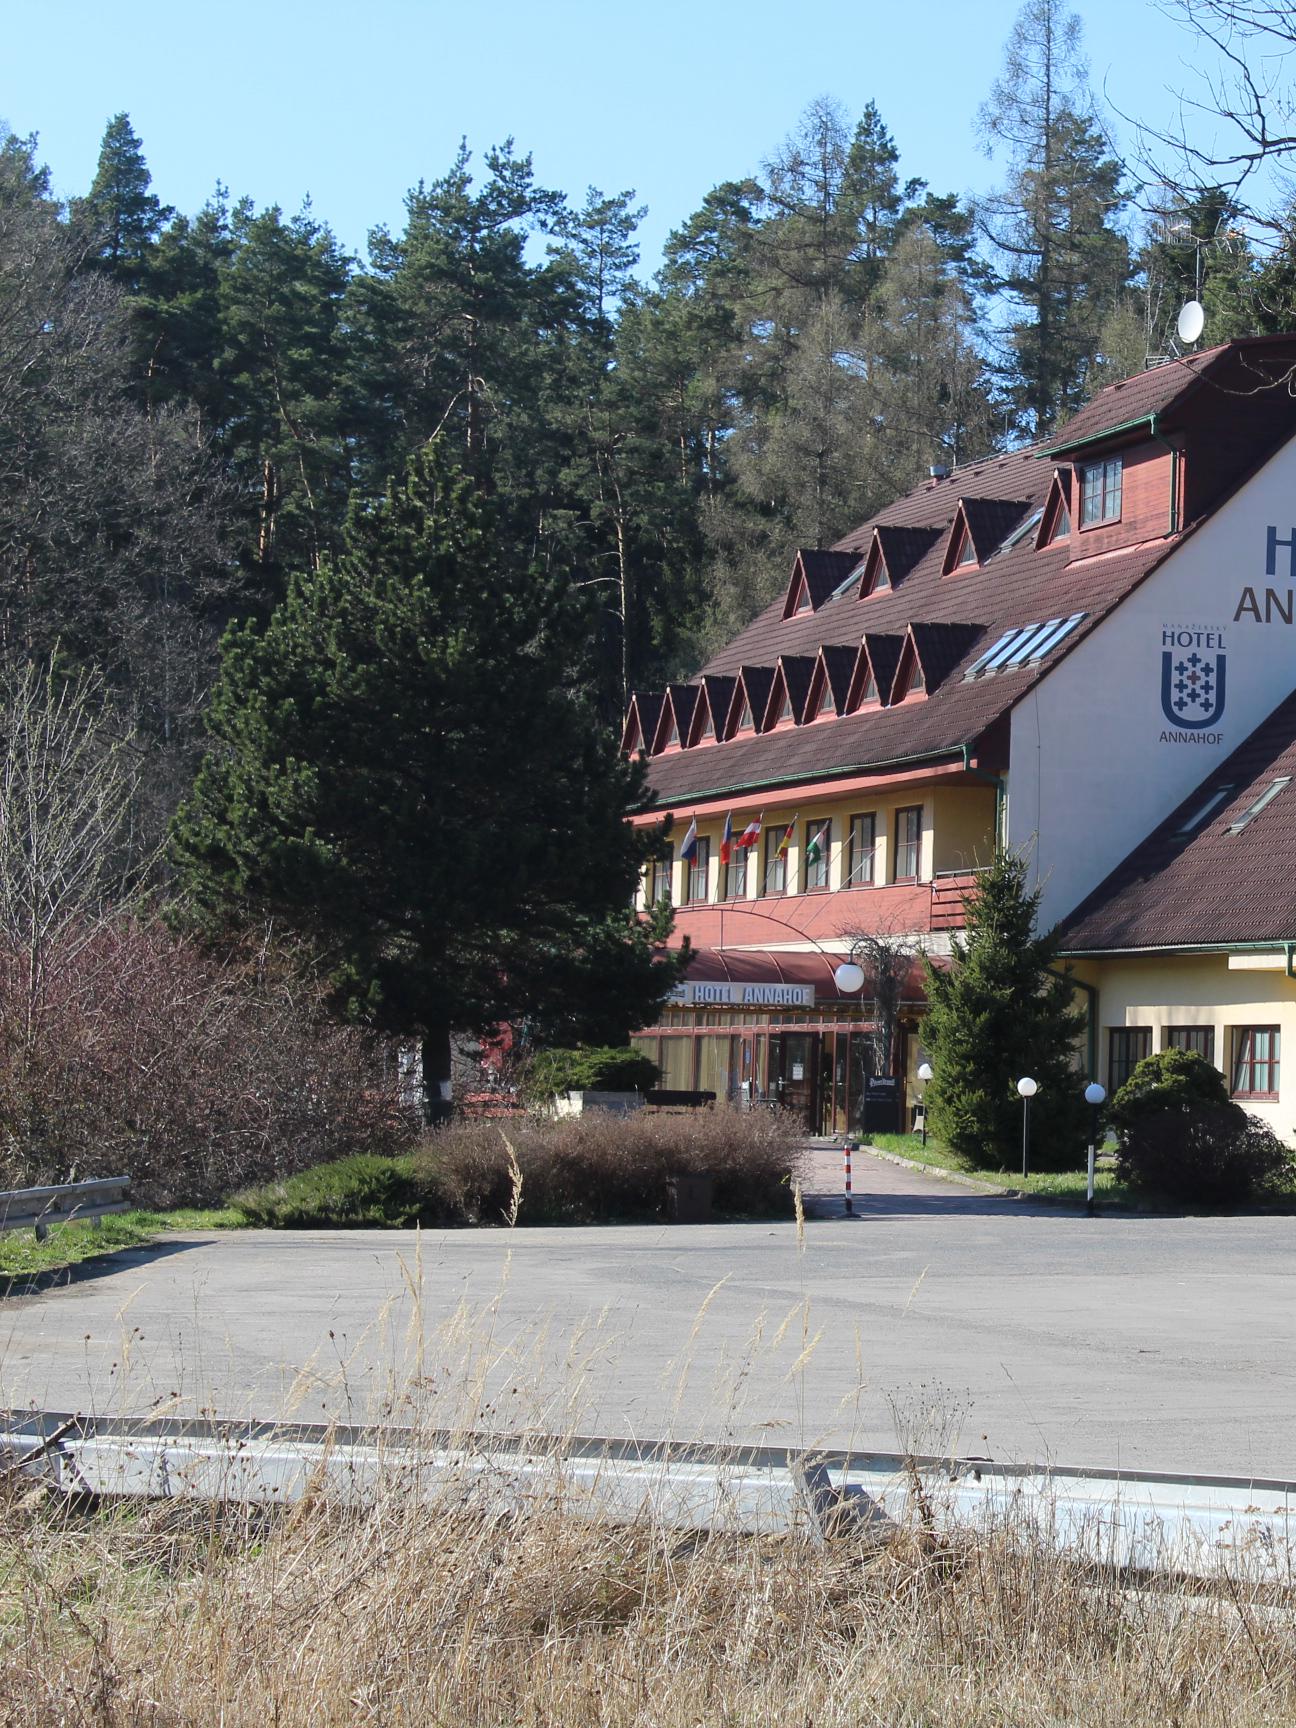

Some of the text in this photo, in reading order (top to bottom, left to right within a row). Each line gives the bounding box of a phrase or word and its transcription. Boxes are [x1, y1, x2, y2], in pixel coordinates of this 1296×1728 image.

[1162, 630, 1226, 649] HOTEL
[1159, 731, 1224, 745] ANNAHOF
[693, 985, 737, 1003] HOTEL
[743, 986, 810, 1005] ANNAHOF
